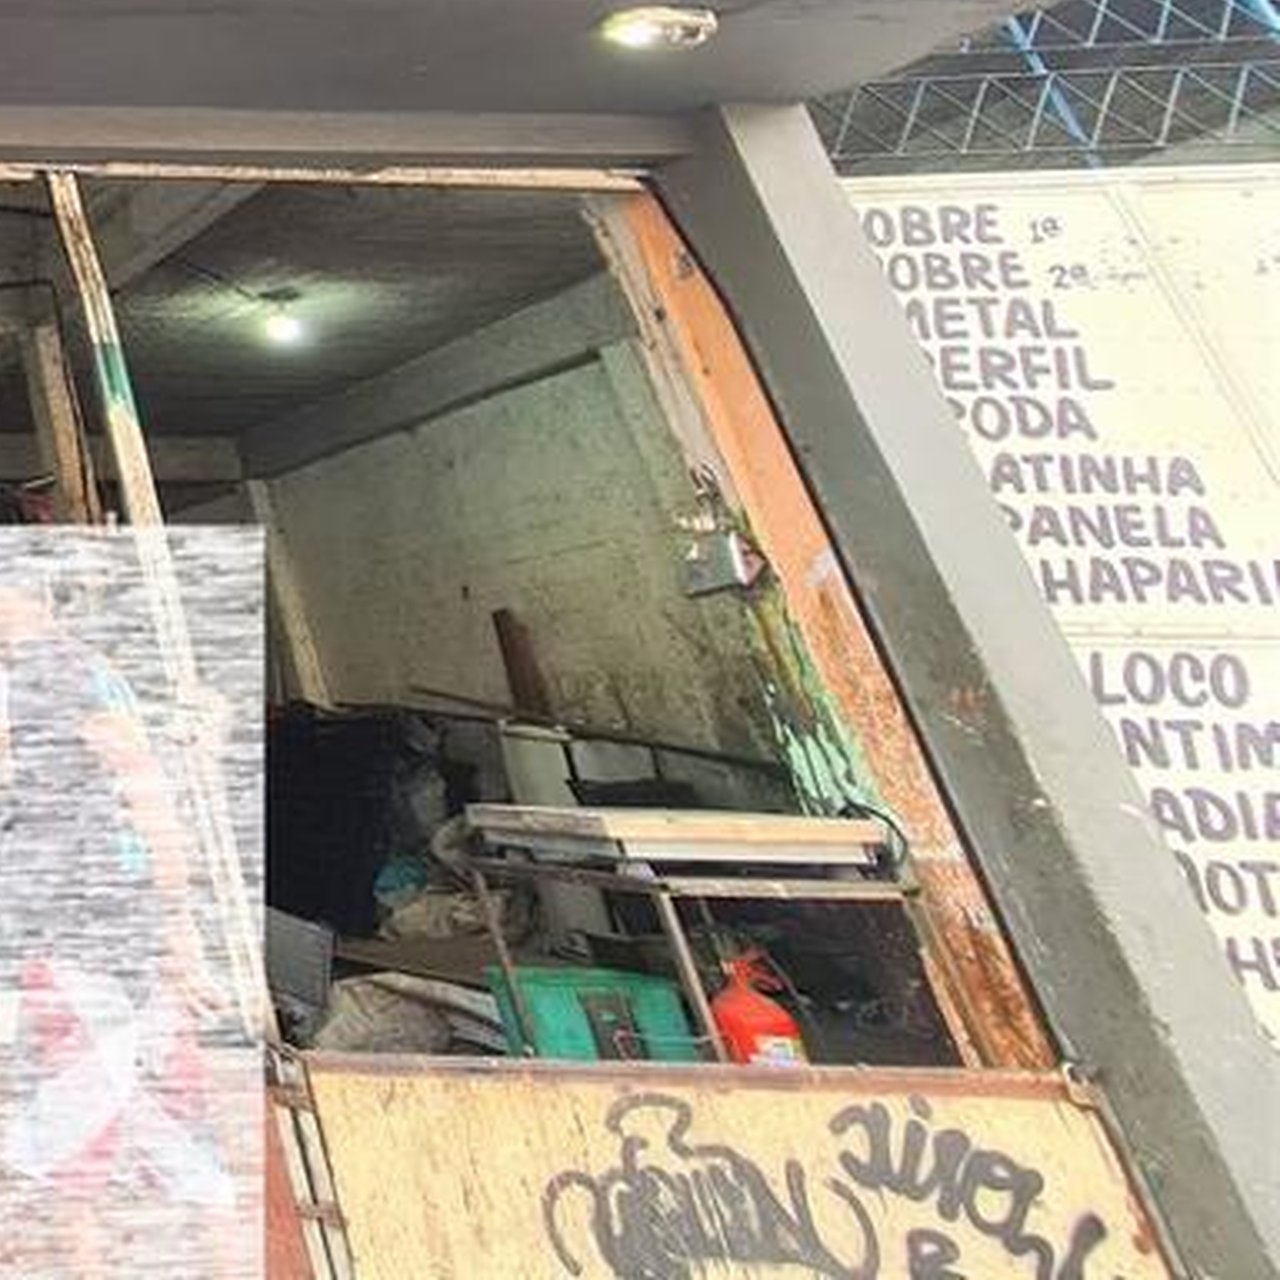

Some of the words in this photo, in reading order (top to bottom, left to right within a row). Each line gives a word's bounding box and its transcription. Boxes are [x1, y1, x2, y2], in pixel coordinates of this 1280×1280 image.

[857, 204, 1004, 248] OBRE
[875, 251, 1030, 292] OBRE
[924, 346, 1117, 391] ERFIL
[990, 452, 1206, 497] ATINHA
[1040, 556, 1280, 605] HAPARI
[1090, 651, 1249, 708] LOCO
[1120, 716, 1280, 772] NTIM
[1149, 786, 1280, 843] ADI
